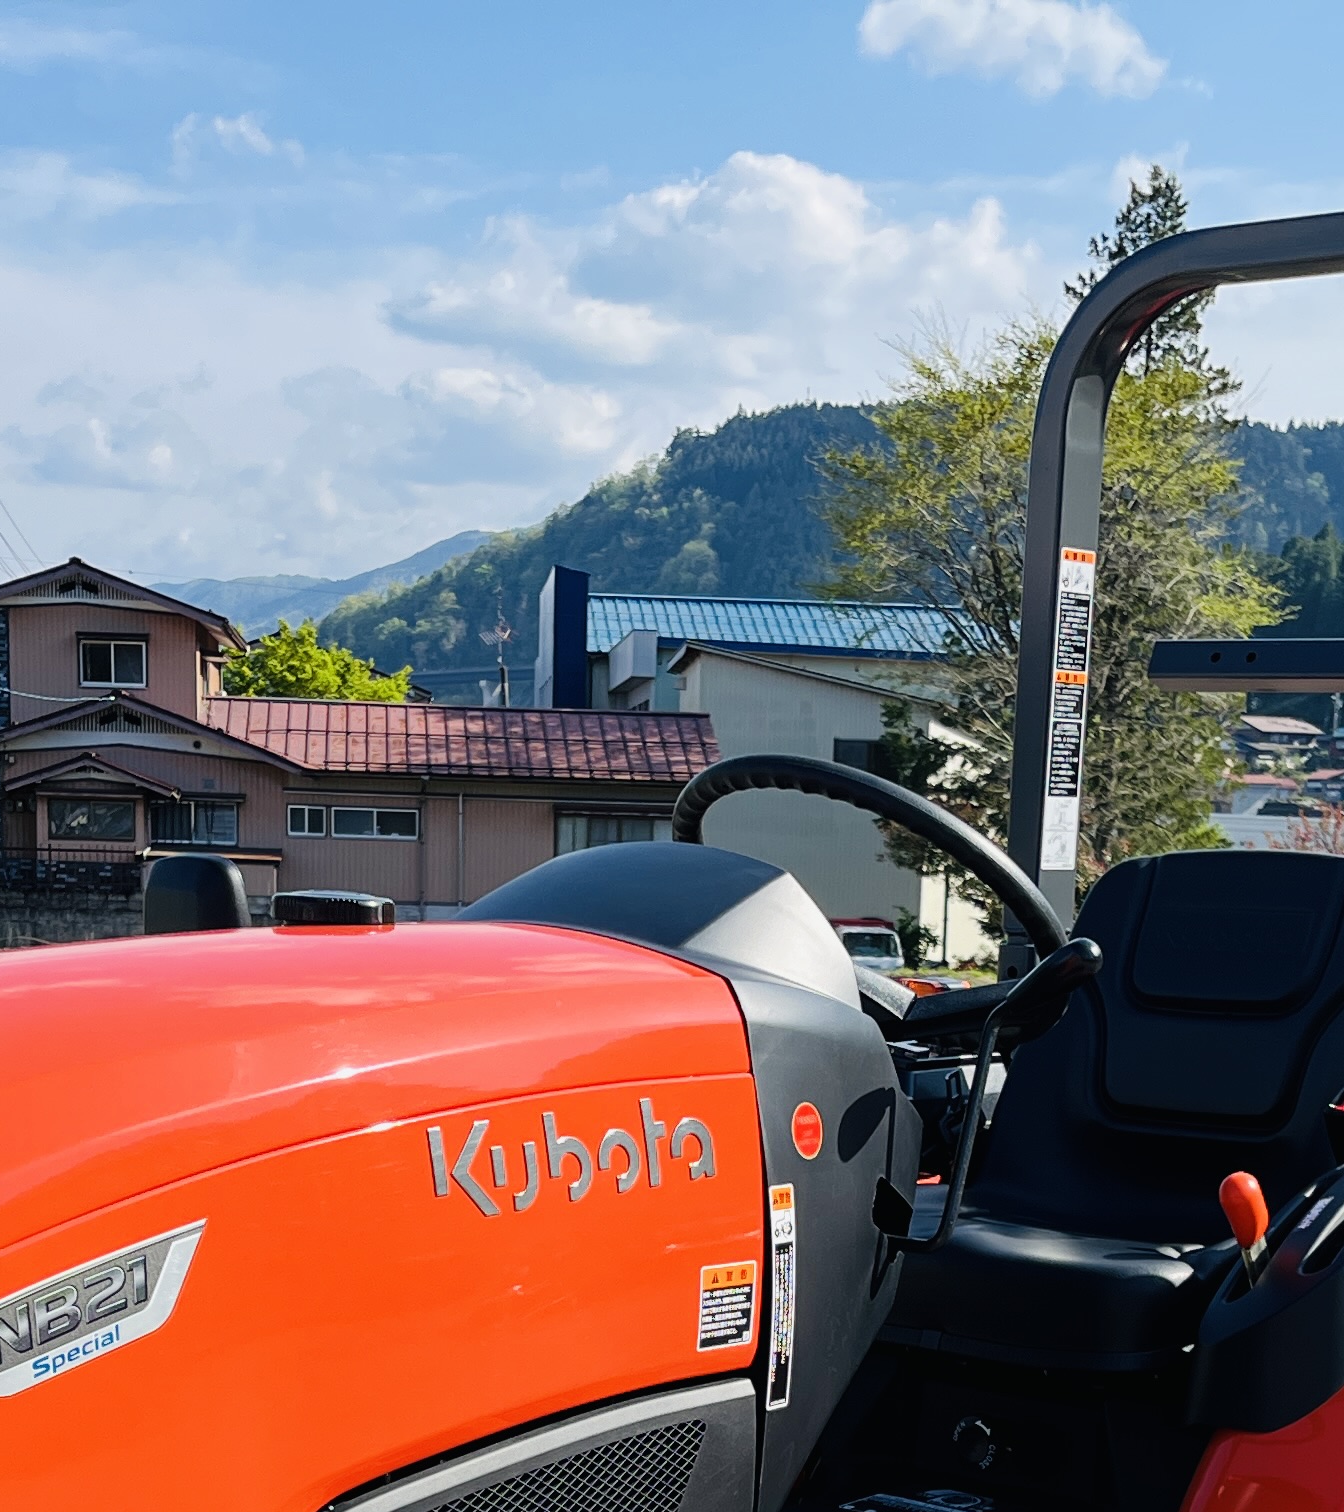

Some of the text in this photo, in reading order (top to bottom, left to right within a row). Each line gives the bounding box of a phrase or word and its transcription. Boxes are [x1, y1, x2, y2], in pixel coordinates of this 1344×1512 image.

[426, 1097, 715, 1217] Kubota
[32, 1324, 120, 1379] Special
[978, 1444, 997, 1470] CLOSE
